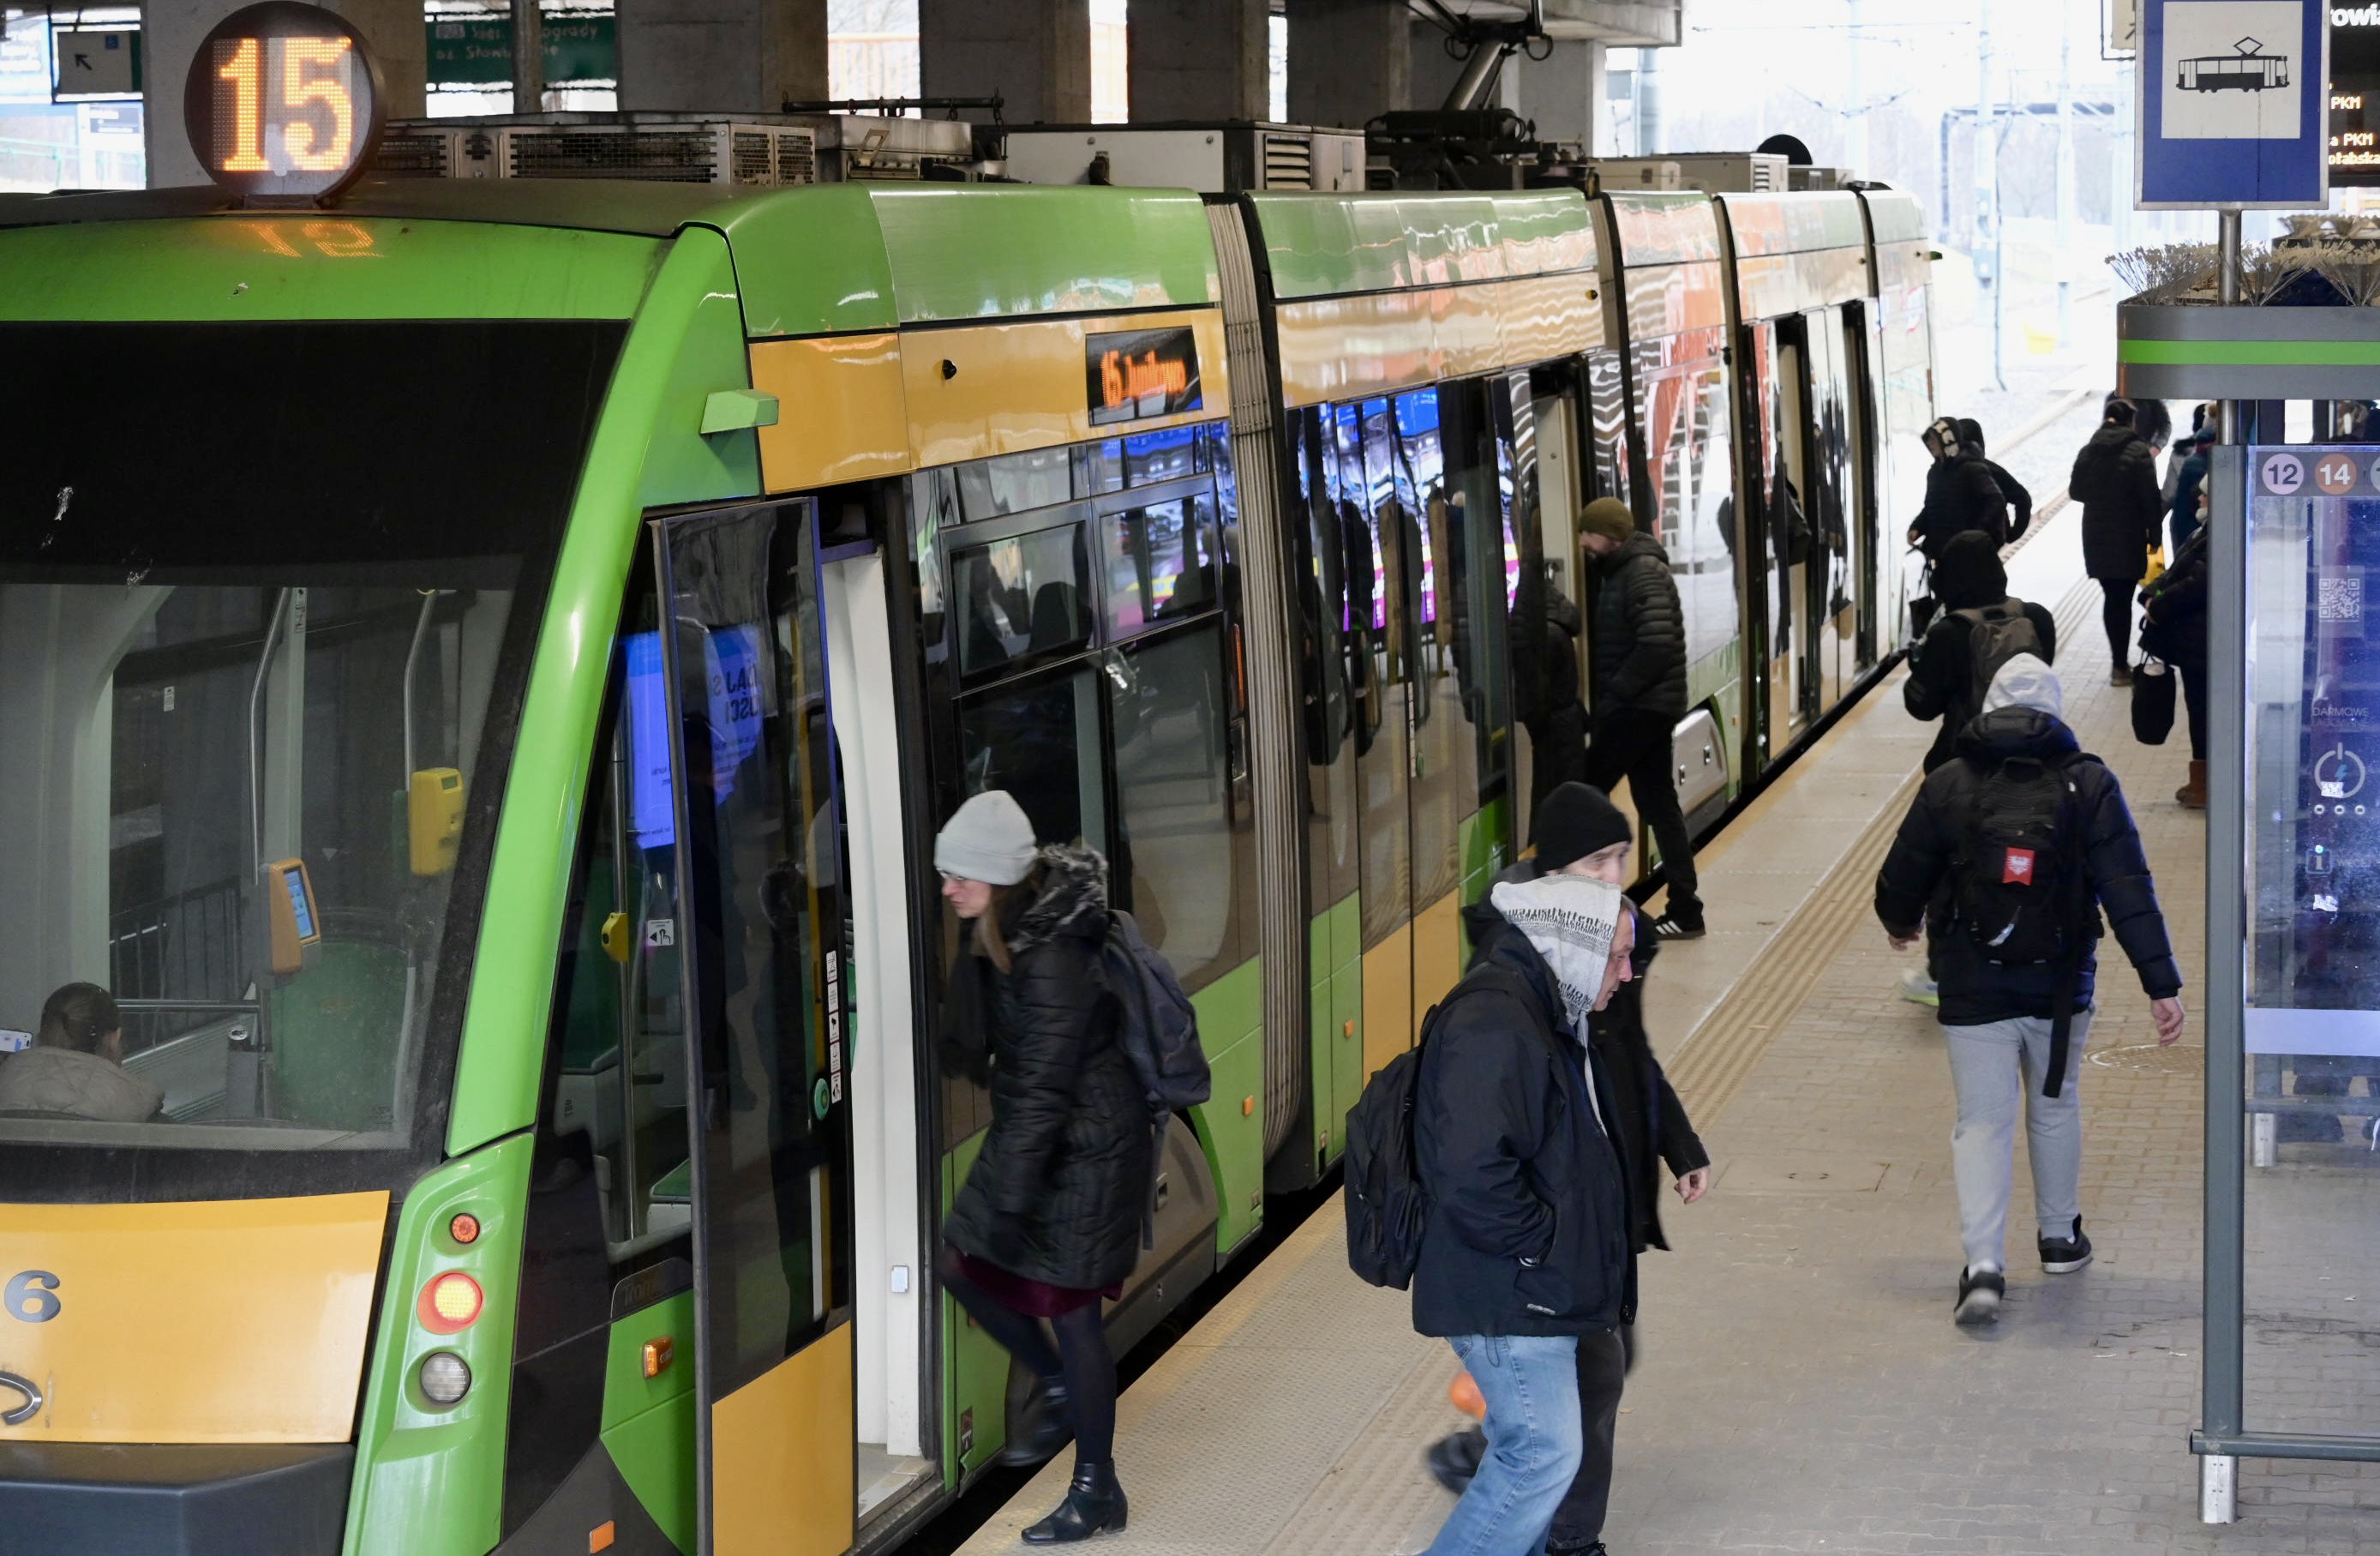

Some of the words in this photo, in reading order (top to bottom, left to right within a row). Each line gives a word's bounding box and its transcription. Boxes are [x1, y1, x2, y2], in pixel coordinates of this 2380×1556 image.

[2330, 3, 2380, 27] owi
[220, 38, 352, 171] 15
[2331, 96, 2361, 109] PKM
[2329, 136, 2338, 146] a
[2344, 133, 2373, 146] PKM
[2329, 151, 2380, 164] ołabska
[2268, 464, 2298, 484] 12
[2320, 464, 2351, 485] 14
[4, 1270, 61, 1323] 6
